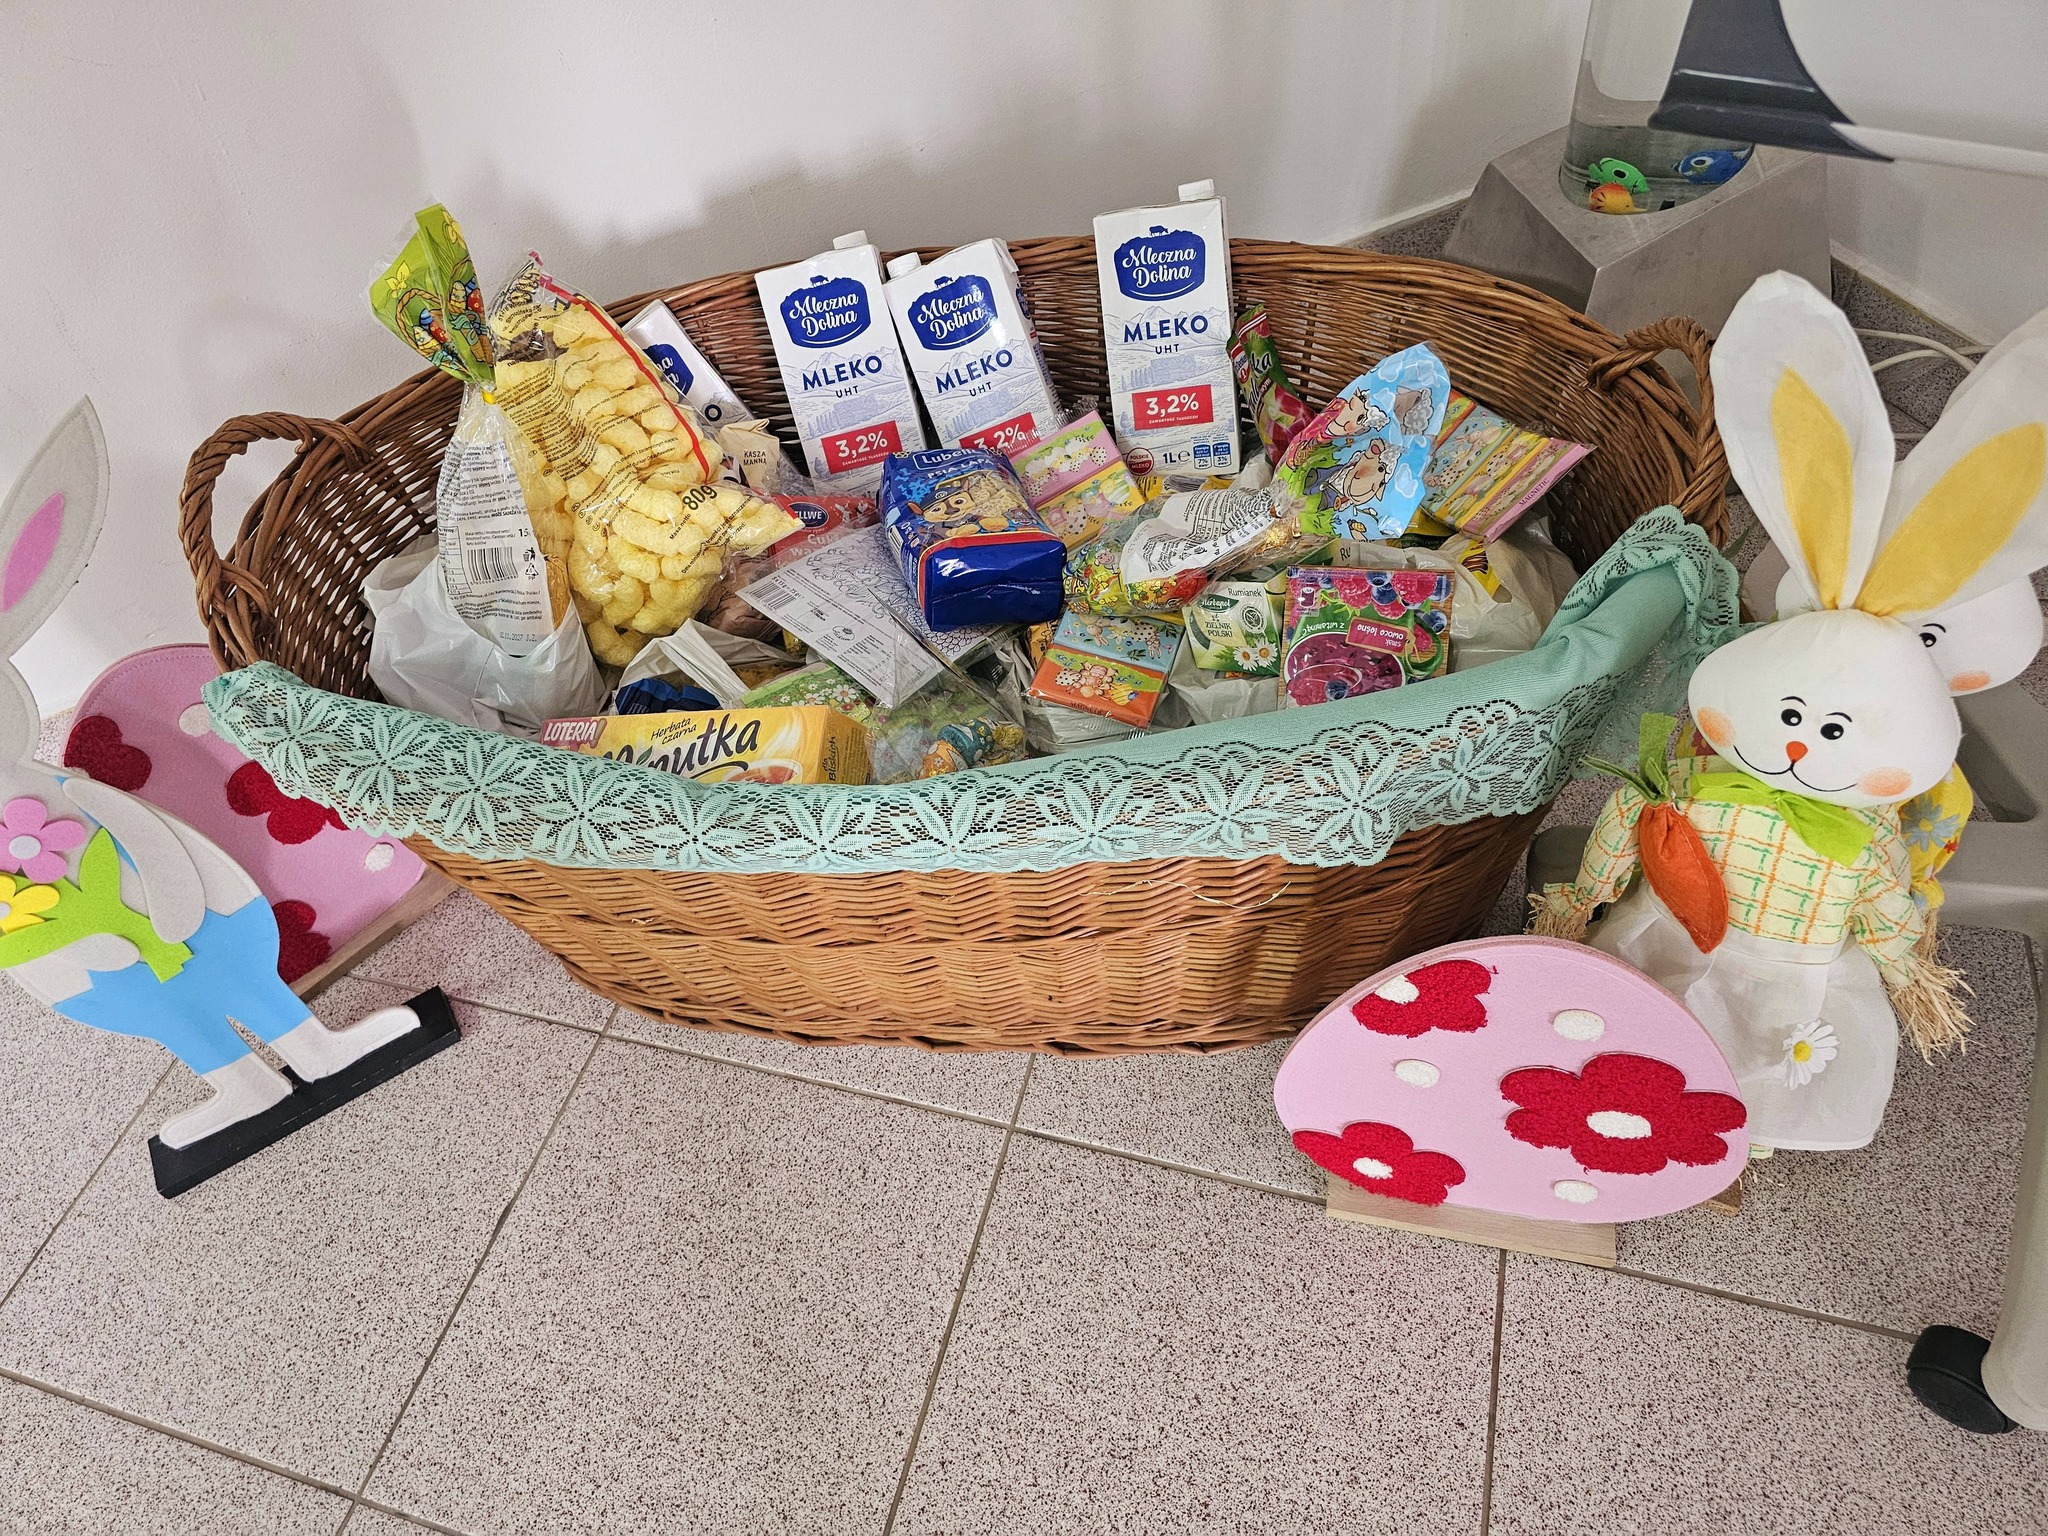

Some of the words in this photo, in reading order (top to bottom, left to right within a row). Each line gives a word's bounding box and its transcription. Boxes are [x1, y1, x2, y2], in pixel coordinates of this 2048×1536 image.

[1122, 245, 1197, 268] Mleczna
[1133, 264, 1192, 288] Dolina
[789, 294, 859, 319] Mleczna
[917, 290, 985, 324] Mleczna
[801, 310, 858, 337] Dolina
[930, 308, 984, 340] Dolina
[1123, 315, 1209, 343] MLEKO
[1155, 343, 1180, 355] UHT
[802, 355, 882, 391] MLEKO
[935, 350, 1013, 394] MLEKO
[835, 385, 859, 398] UHT
[969, 382, 993, 397] UHT
[1145, 392, 1200, 417] 3,2%
[744, 450, 766, 458] KASZA
[836, 431, 888, 461] 3,2%
[1163, 452, 1177, 463] 1L
[927, 467, 955, 479] PSIA
[683, 485, 718, 511] 80g
[1518, 478, 1550, 507] MAGNETIC
[669, 527, 681, 540] Masa
[680, 513, 691, 527] netto
[1228, 588, 1262, 597] Rumianek
[1205, 622, 1232, 630] ZIELNIK
[1357, 623, 1378, 636] leśne
[1380, 628, 1403, 640] owoce
[1385, 639, 1402, 647] smak
[651, 718, 691, 741] Herbata
[662, 725, 697, 745] czarna
[828, 736, 837, 781] Bliskich
